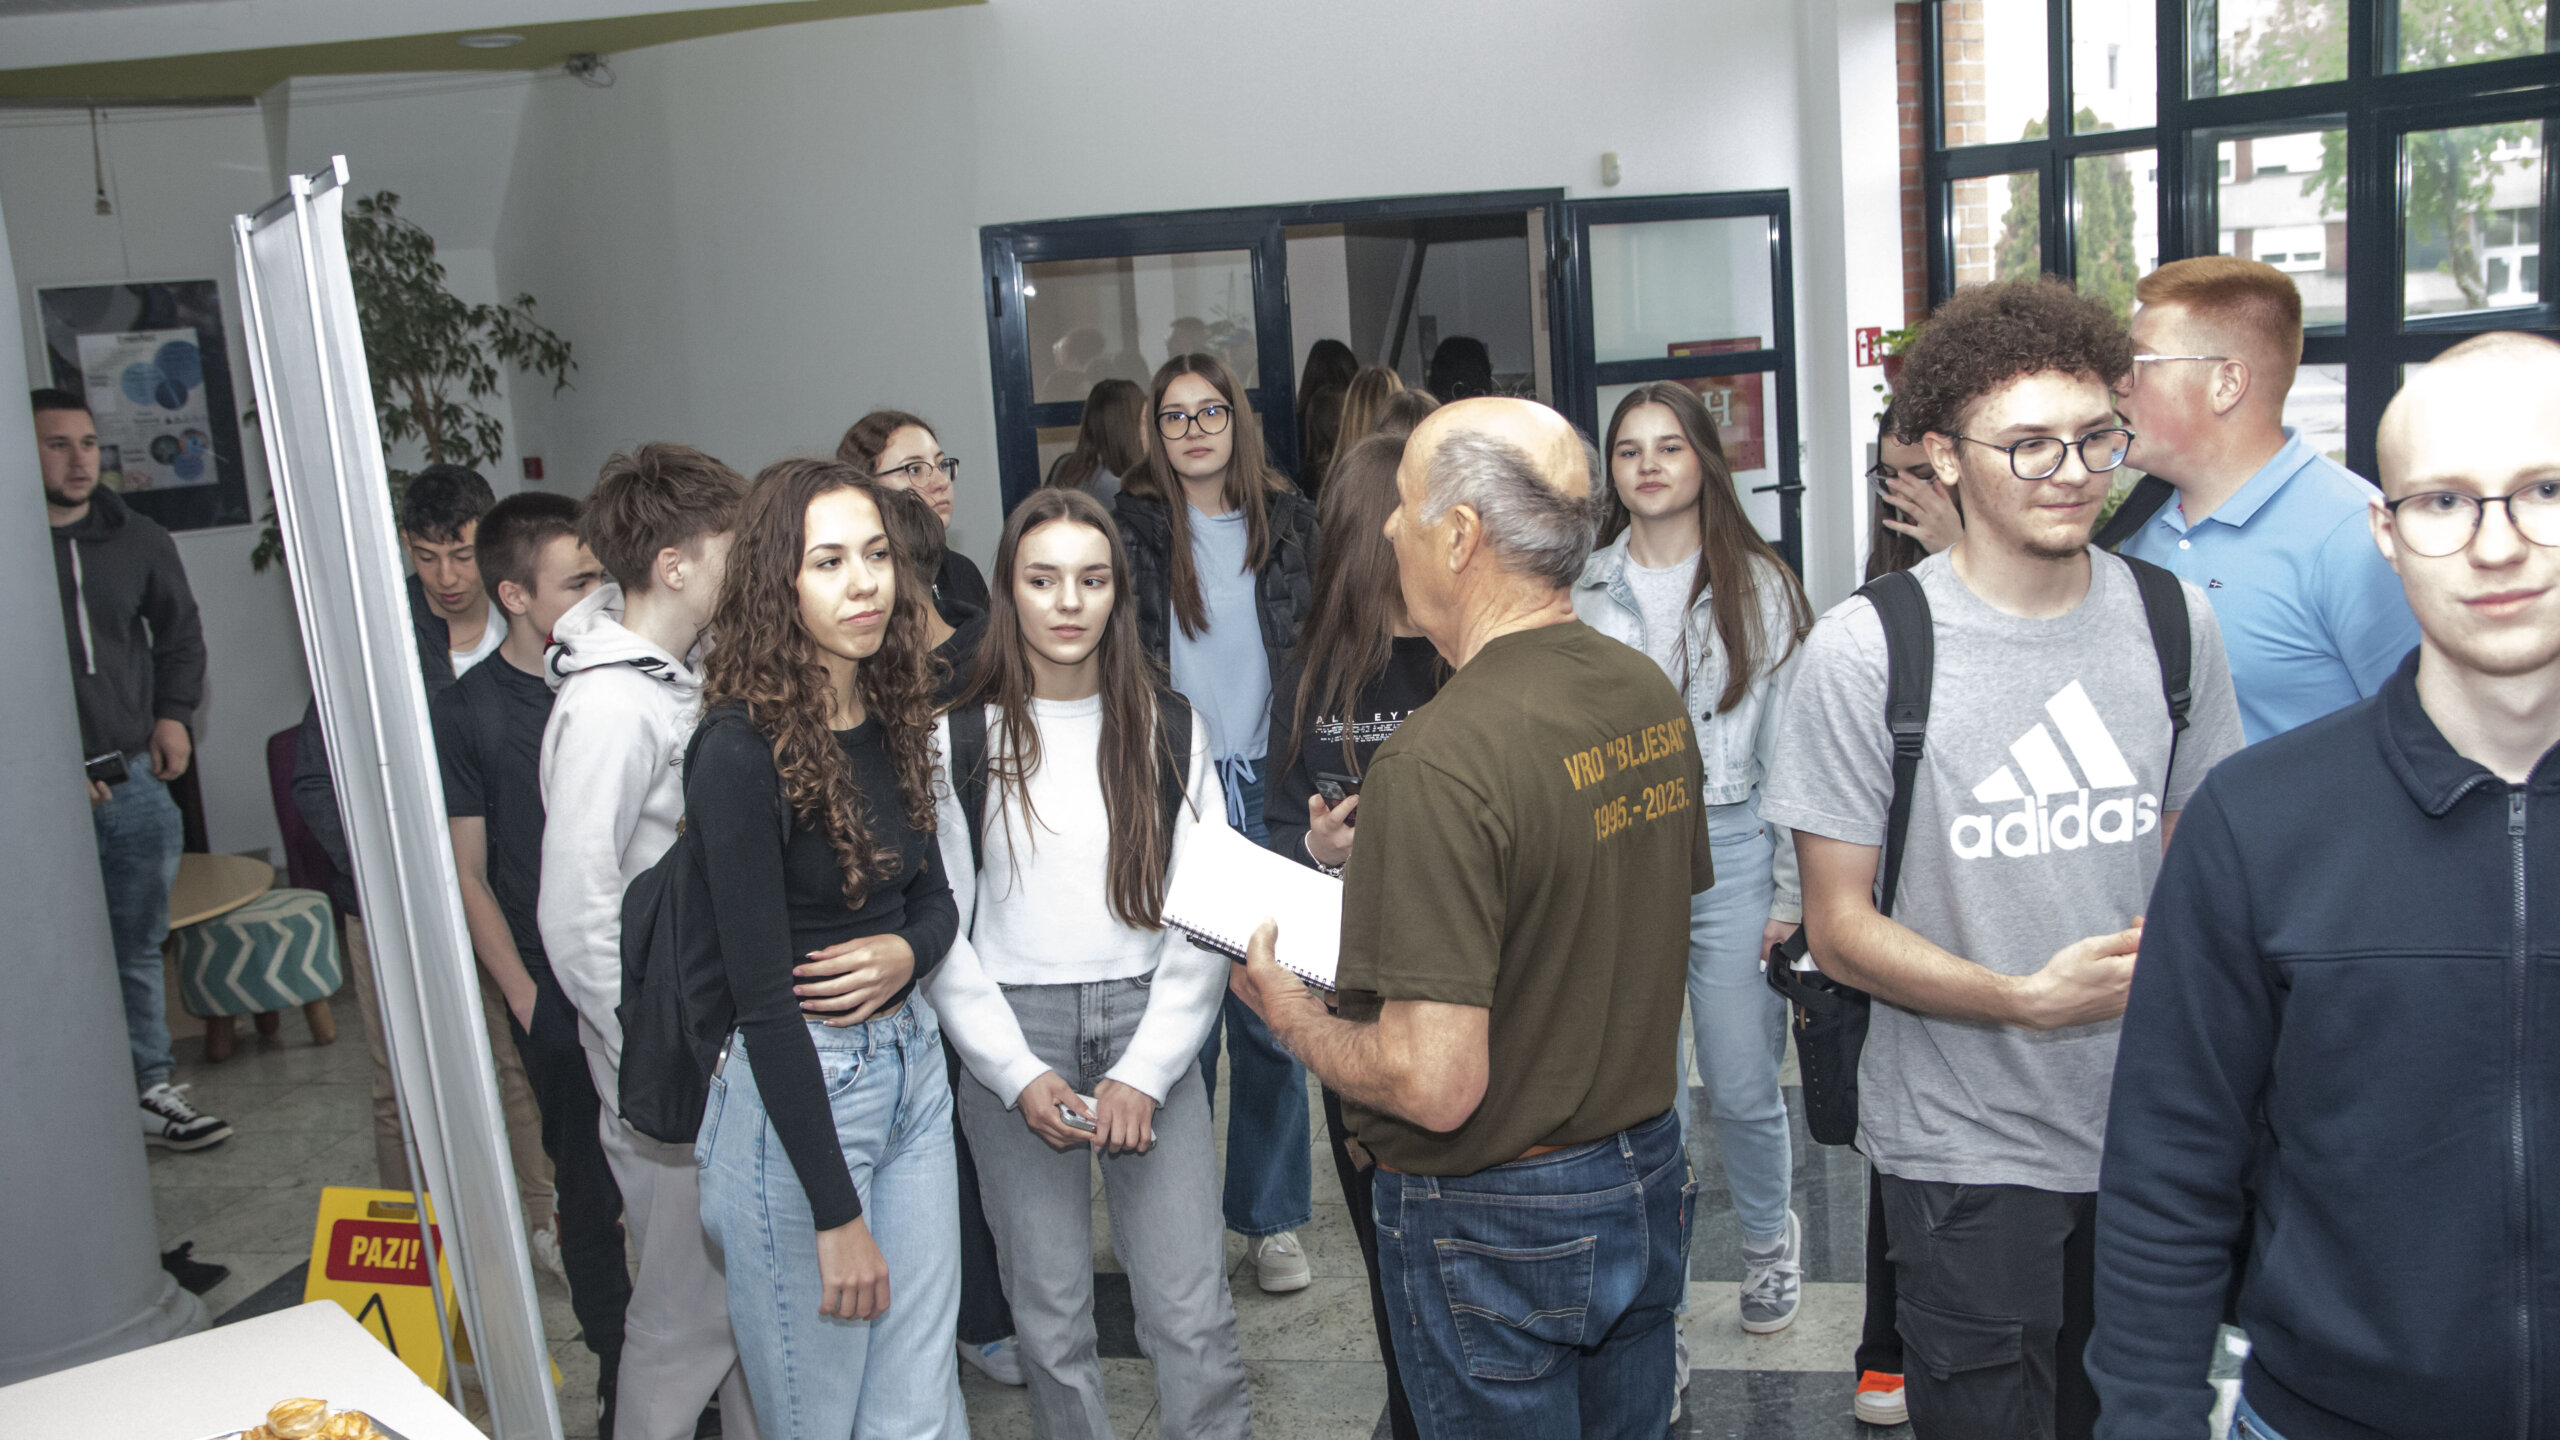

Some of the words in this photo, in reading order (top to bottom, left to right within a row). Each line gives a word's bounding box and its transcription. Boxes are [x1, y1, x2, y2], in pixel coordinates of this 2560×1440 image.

[1563, 746, 1605, 791] VRO
[1950, 788, 2158, 860] adidas
[348, 1235, 420, 1270] PAZI!
